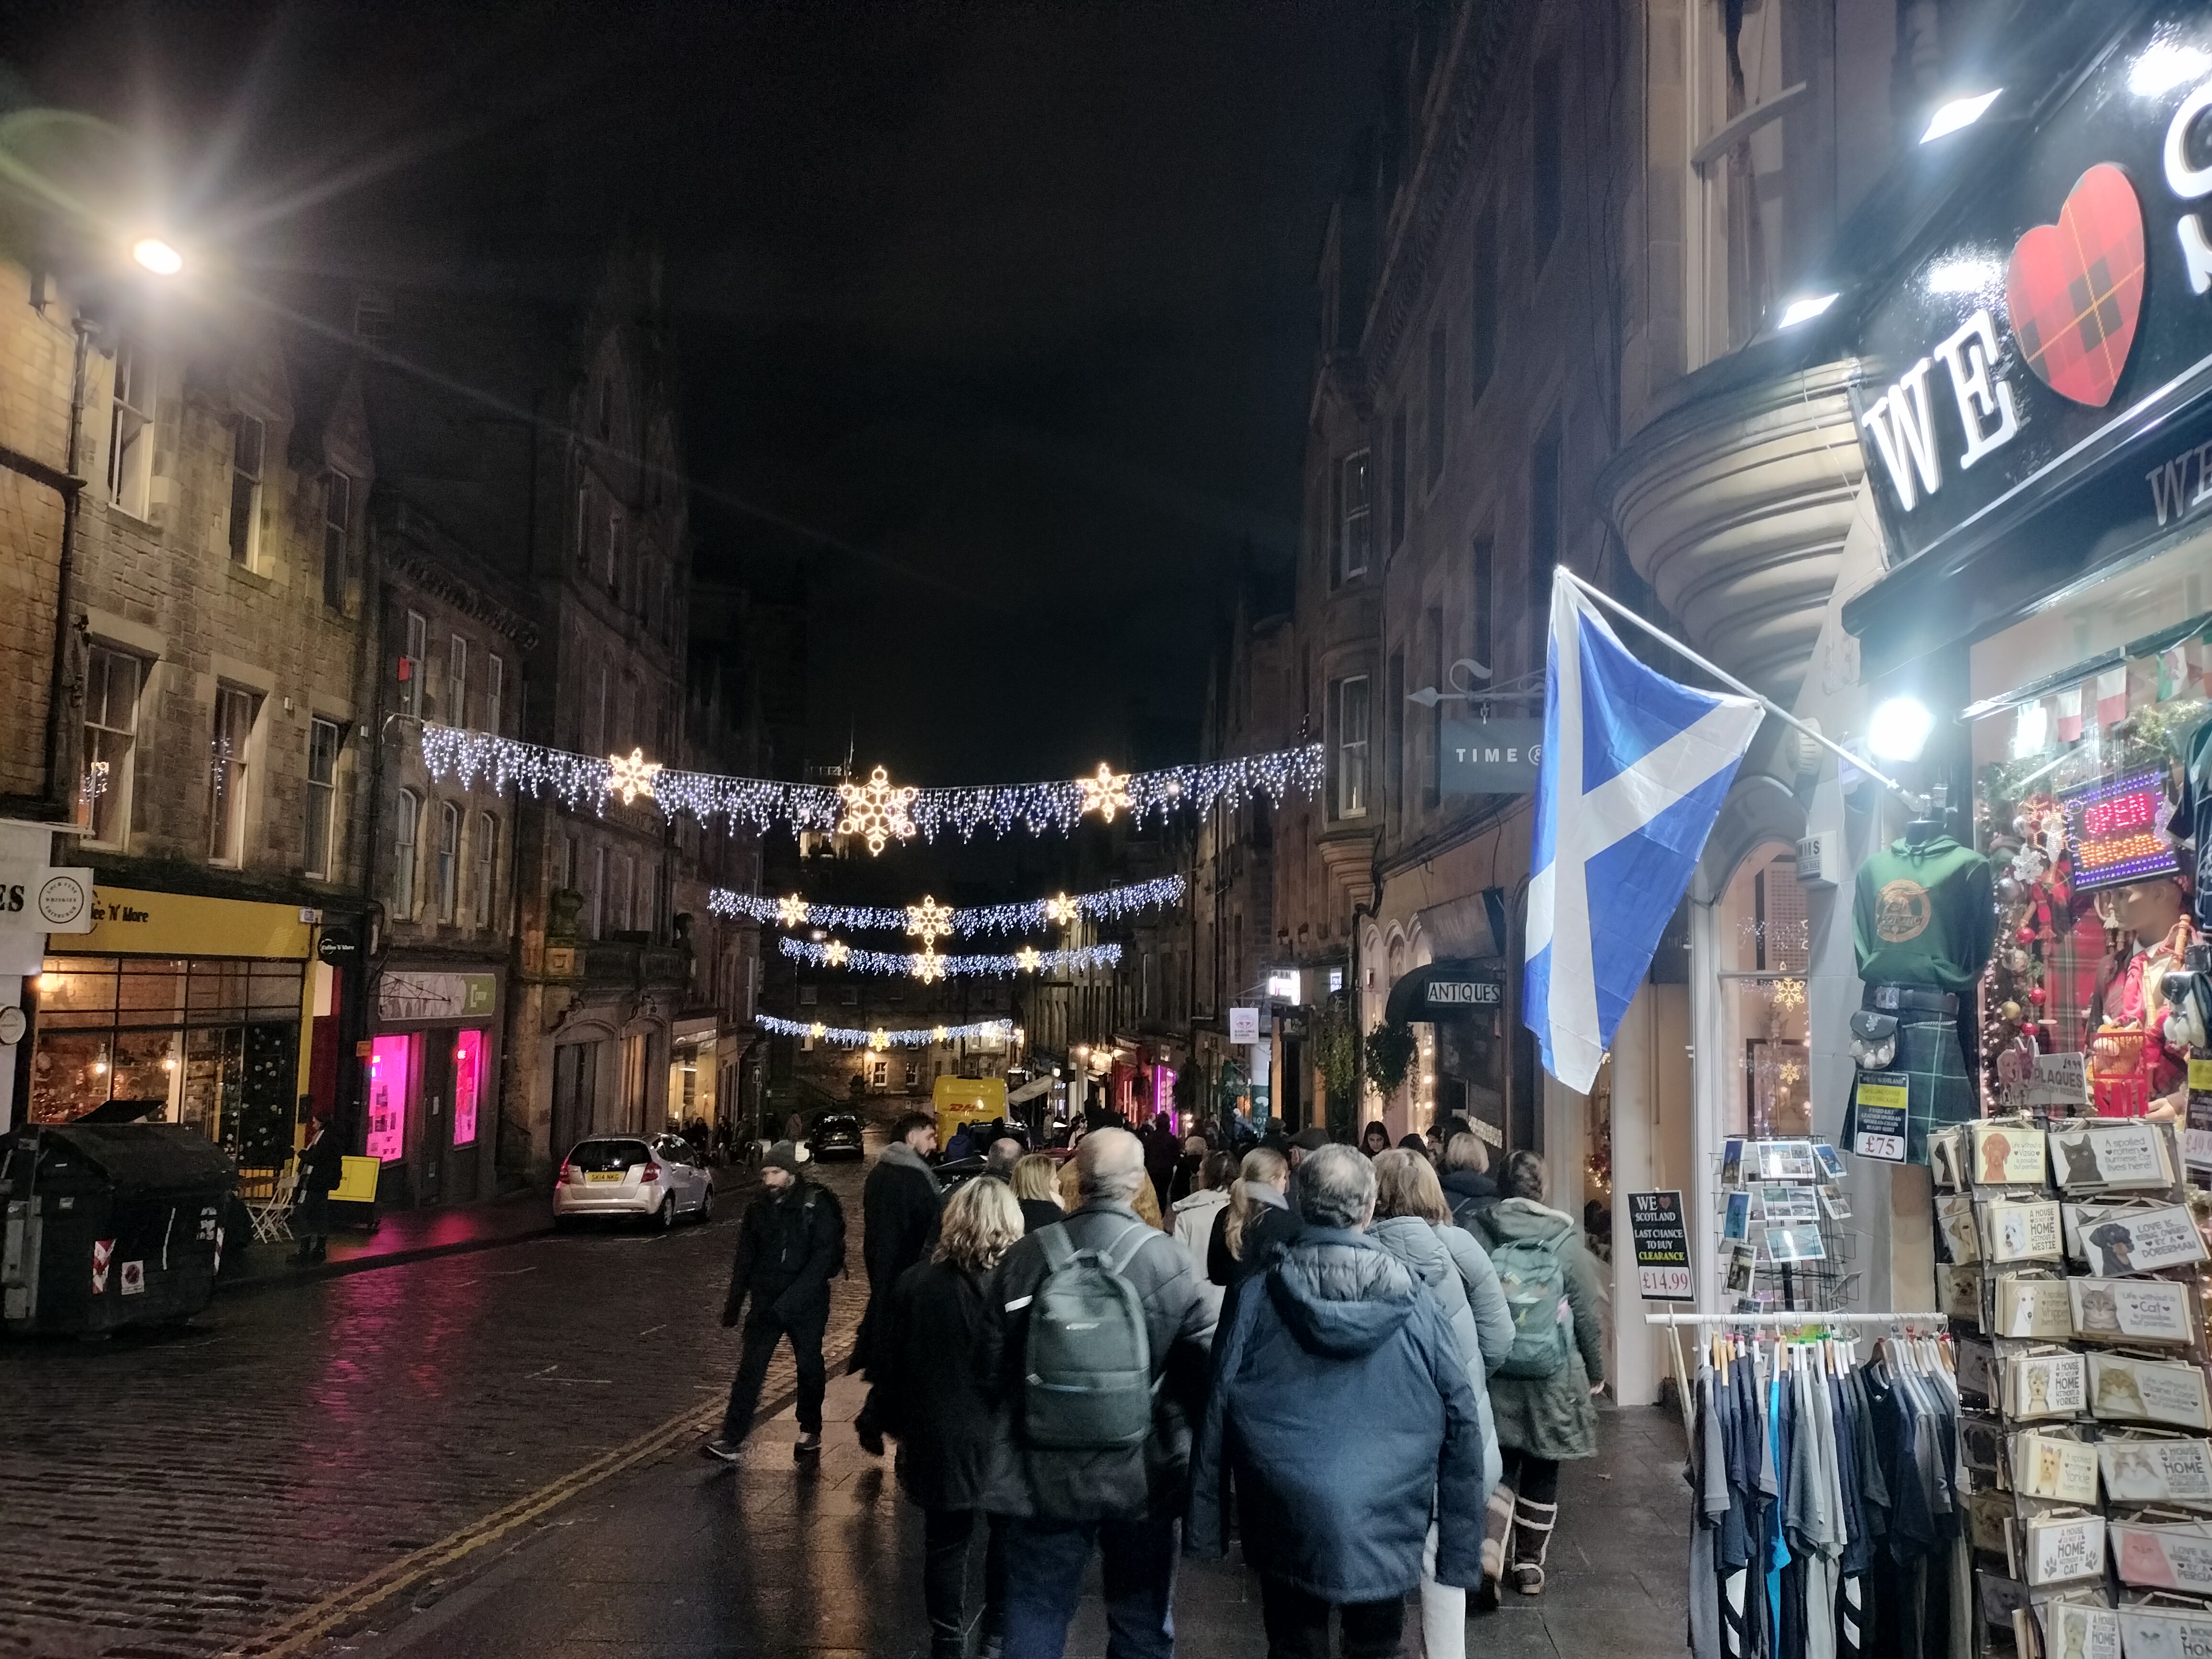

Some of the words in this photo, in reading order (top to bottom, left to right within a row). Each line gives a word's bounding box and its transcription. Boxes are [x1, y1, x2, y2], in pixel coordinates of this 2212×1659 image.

[1861, 309, 2018, 512] WE
[1456, 748, 1518, 763] TIME
[2084, 793, 2147, 834] OPEN
[122, 907, 149, 922] More
[1428, 983, 1500, 1002] ANTIQUES
[2034, 1067, 2083, 1089] PLAQUES
[1865, 1135, 1895, 1155] £75
[2113, 1137, 2145, 1148] spoiled
[1637, 1196, 1658, 1211] WE
[1635, 1212, 1676, 1222] SCOTLAND
[2030, 1210, 2034, 1218] A
[2035, 1208, 2054, 1217] HOUSE
[2031, 1222, 2055, 1235] HOME
[2137, 1221, 2162, 1233] LOVE
[1635, 1229, 1652, 1238] LAST
[1652, 1229, 1684, 1238] CHANCE
[2031, 1234, 2051, 1242] WITHOUT
[1646, 1240, 1657, 1249] TO
[1658, 1240, 1673, 1250] BUY
[2032, 1240, 2056, 1251] WESTIE
[2141, 1240, 2197, 1258] DOBERMAN
[1638, 1251, 1685, 1261] CLEARANCE
[1643, 1272, 1688, 1291] £14.99
[2139, 1301, 2161, 1313] Cat
[2041, 1307, 2068, 1321] Whippet
[2061, 1361, 2079, 1371] HOUSE
[2056, 1376, 2079, 1390] HOME
[2056, 1396, 2079, 1406] YORKIE
[2067, 1452, 2070, 1460] A
[2160, 1448, 2167, 1456] A
[2169, 1447, 2201, 1455] HOUSE
[2164, 1461, 2205, 1474] HOME
[2065, 1469, 2090, 1484] Yorkie
[2061, 1528, 2065, 1537] A
[2067, 1526, 2084, 1535] HOUSE
[2058, 1541, 2085, 1559] HOME
[2172, 1545, 2198, 1556] LOVE
[2064, 1563, 2079, 1575] CAT
[2092, 1614, 2097, 1624] A
[2180, 1626, 2187, 1636] A
[2092, 1630, 2115, 1646] HOME
